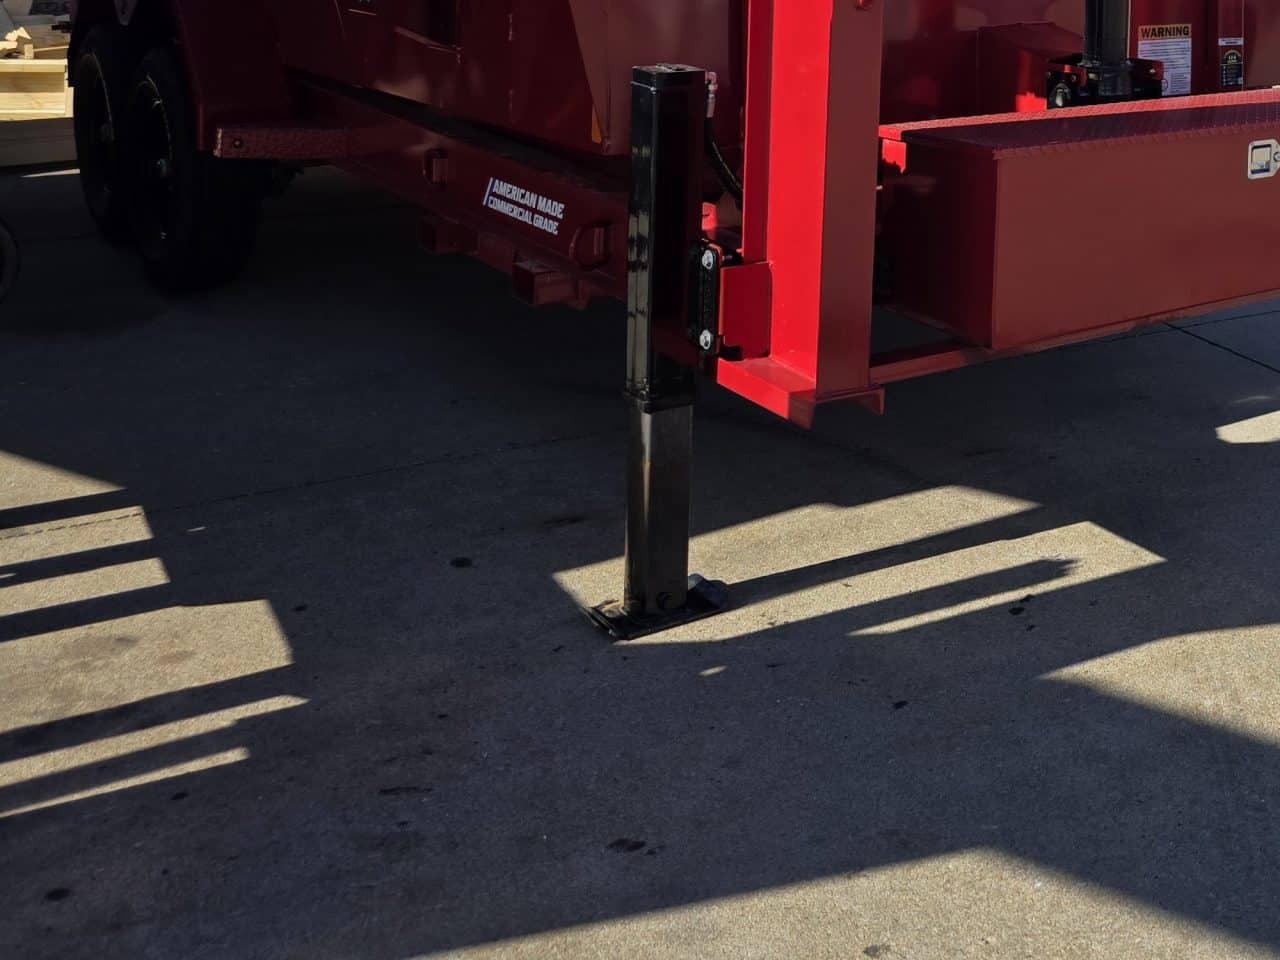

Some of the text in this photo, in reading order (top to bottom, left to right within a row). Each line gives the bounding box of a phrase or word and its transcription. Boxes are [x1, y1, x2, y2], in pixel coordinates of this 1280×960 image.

[1141, 25, 1190, 38] WARNING
[487, 196, 559, 235] COMMERCIAL GRADE
[492, 179, 565, 219] AMERICAN MADE
